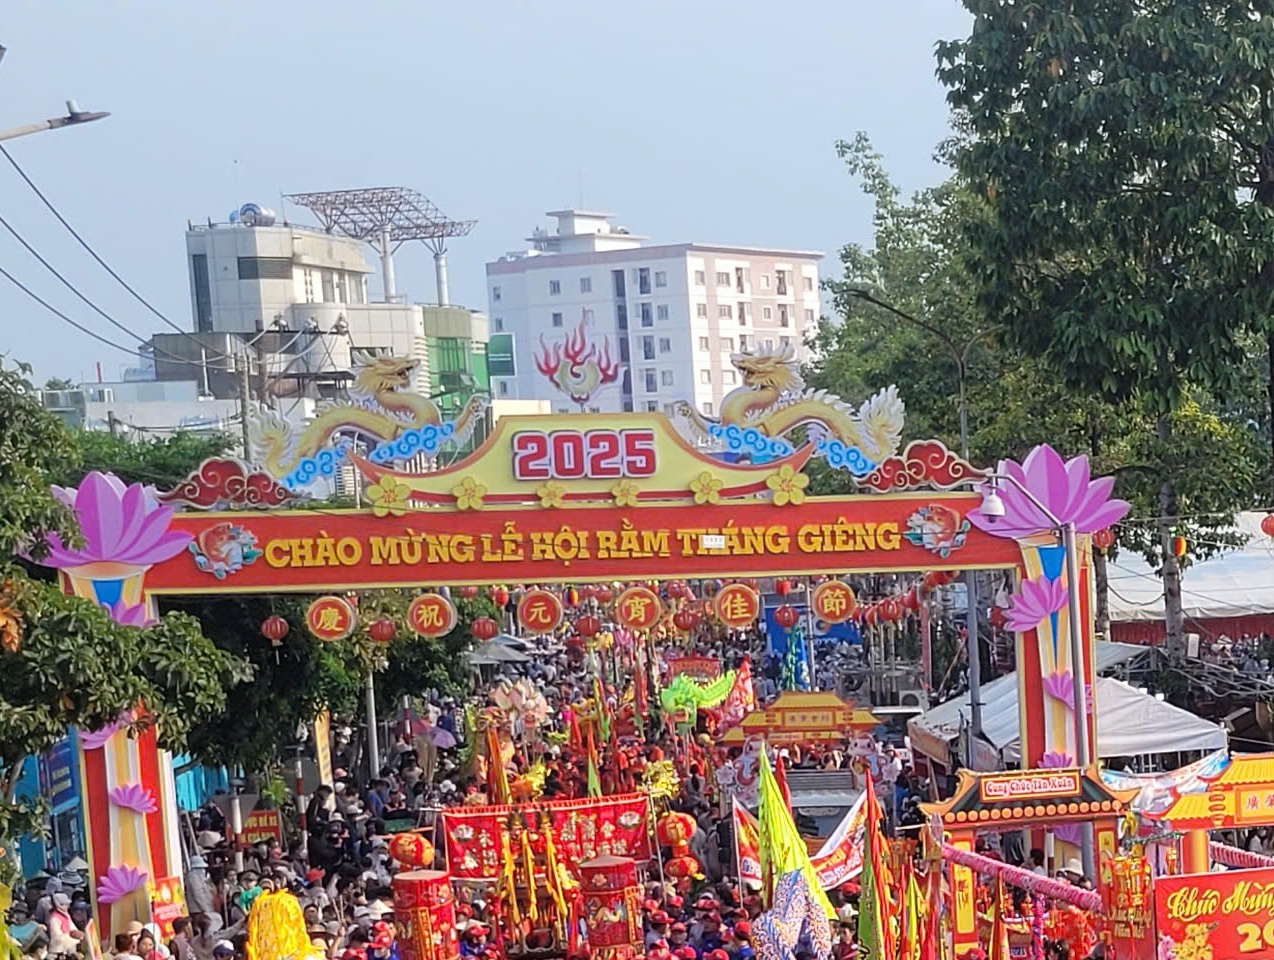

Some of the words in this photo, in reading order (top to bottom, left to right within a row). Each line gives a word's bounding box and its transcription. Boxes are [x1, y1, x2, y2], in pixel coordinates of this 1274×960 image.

[513, 429, 657, 480] 2025
[265, 530, 362, 568] CHÀO
[370, 528, 476, 565] MỪNG
[481, 521, 524, 562] LỄ
[531, 525, 590, 566] HỘI
[597, 518, 671, 559] RẰM
[798, 517, 900, 553] GIÊNG
[528, 603, 551, 623] 元
[721, 594, 751, 619] 佳
[986, 782, 1009, 796] Cung
[1010, 781, 1031, 794] Chúc
[1049, 777, 1073, 791] Xuân
[1168, 887, 1221, 921] Chúc
